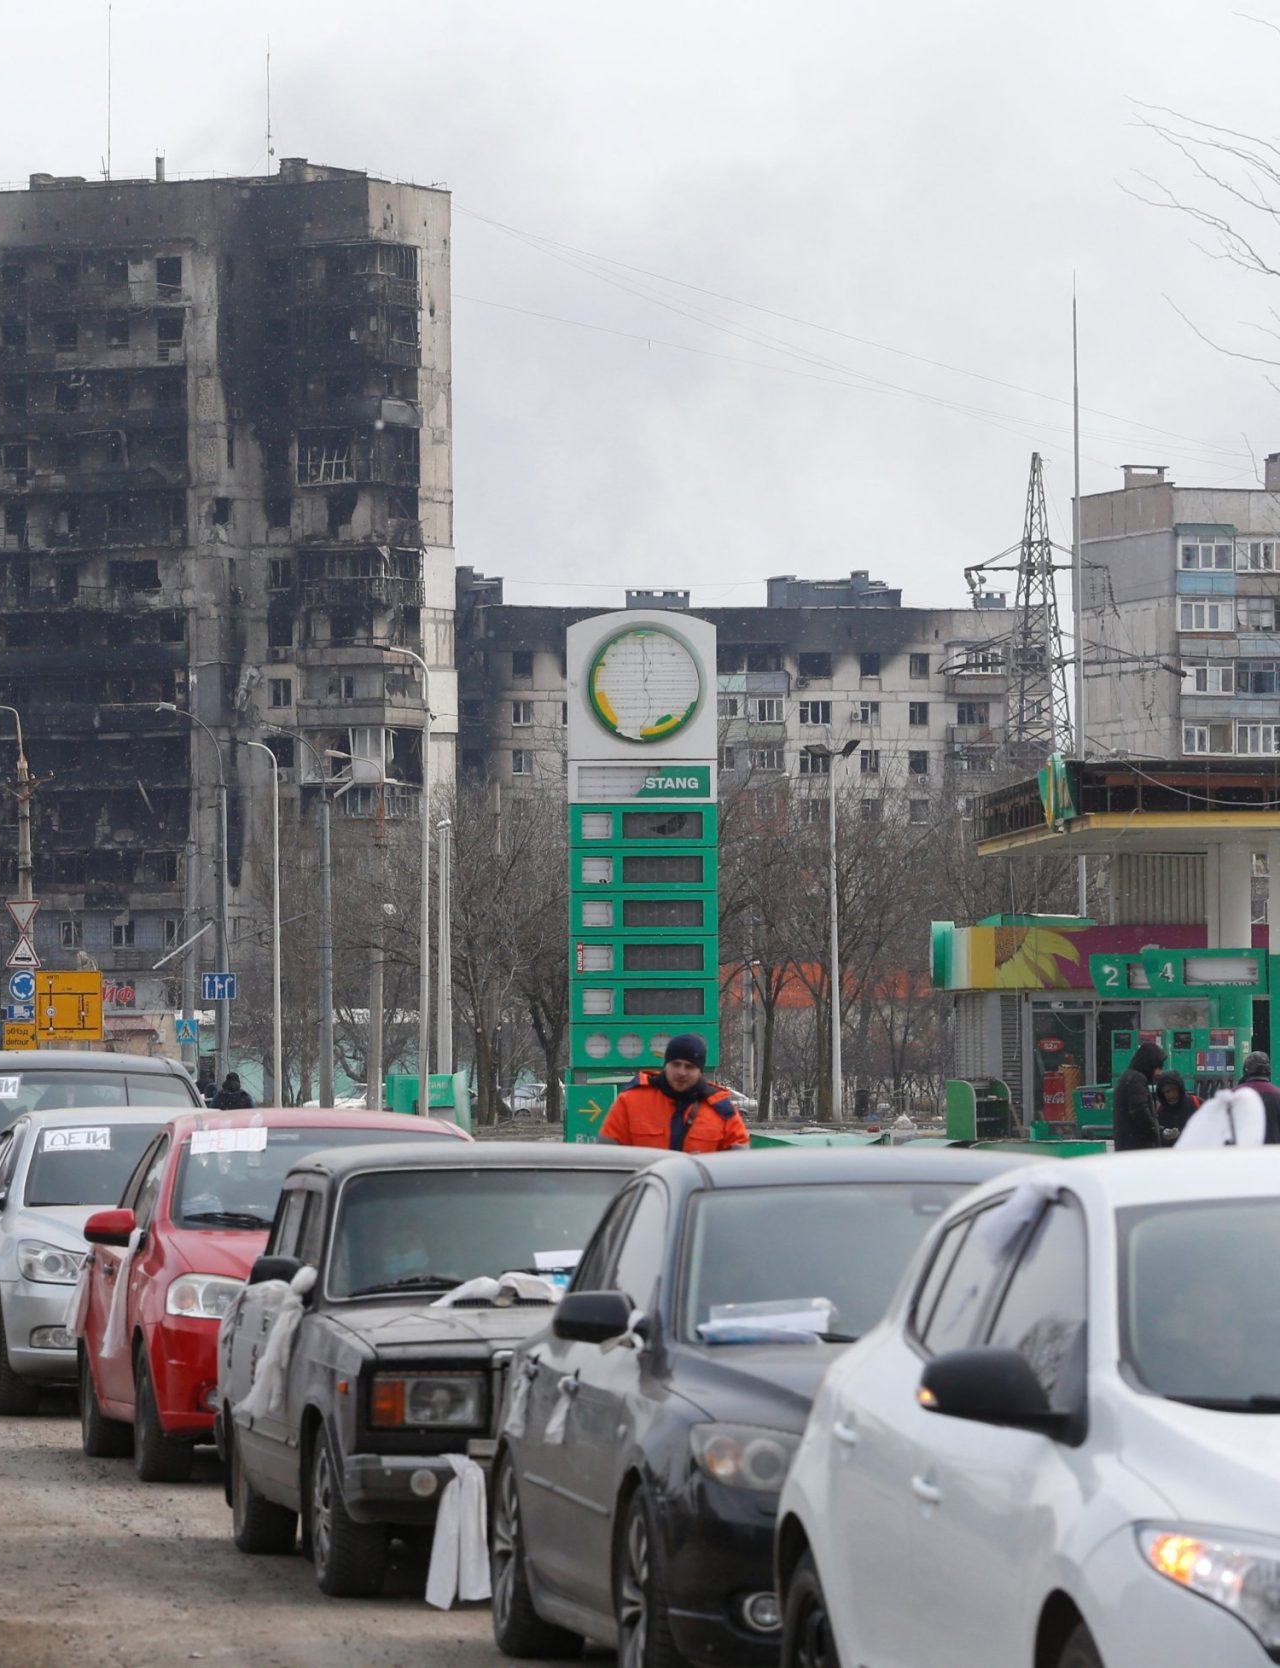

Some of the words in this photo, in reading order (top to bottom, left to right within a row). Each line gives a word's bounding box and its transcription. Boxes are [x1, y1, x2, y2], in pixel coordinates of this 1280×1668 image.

[641, 777, 699, 789] STANG
[1102, 965, 1119, 986] 2
[1160, 962, 1175, 983] 4
[46, 1131, 108, 1148] ДЕТИ
